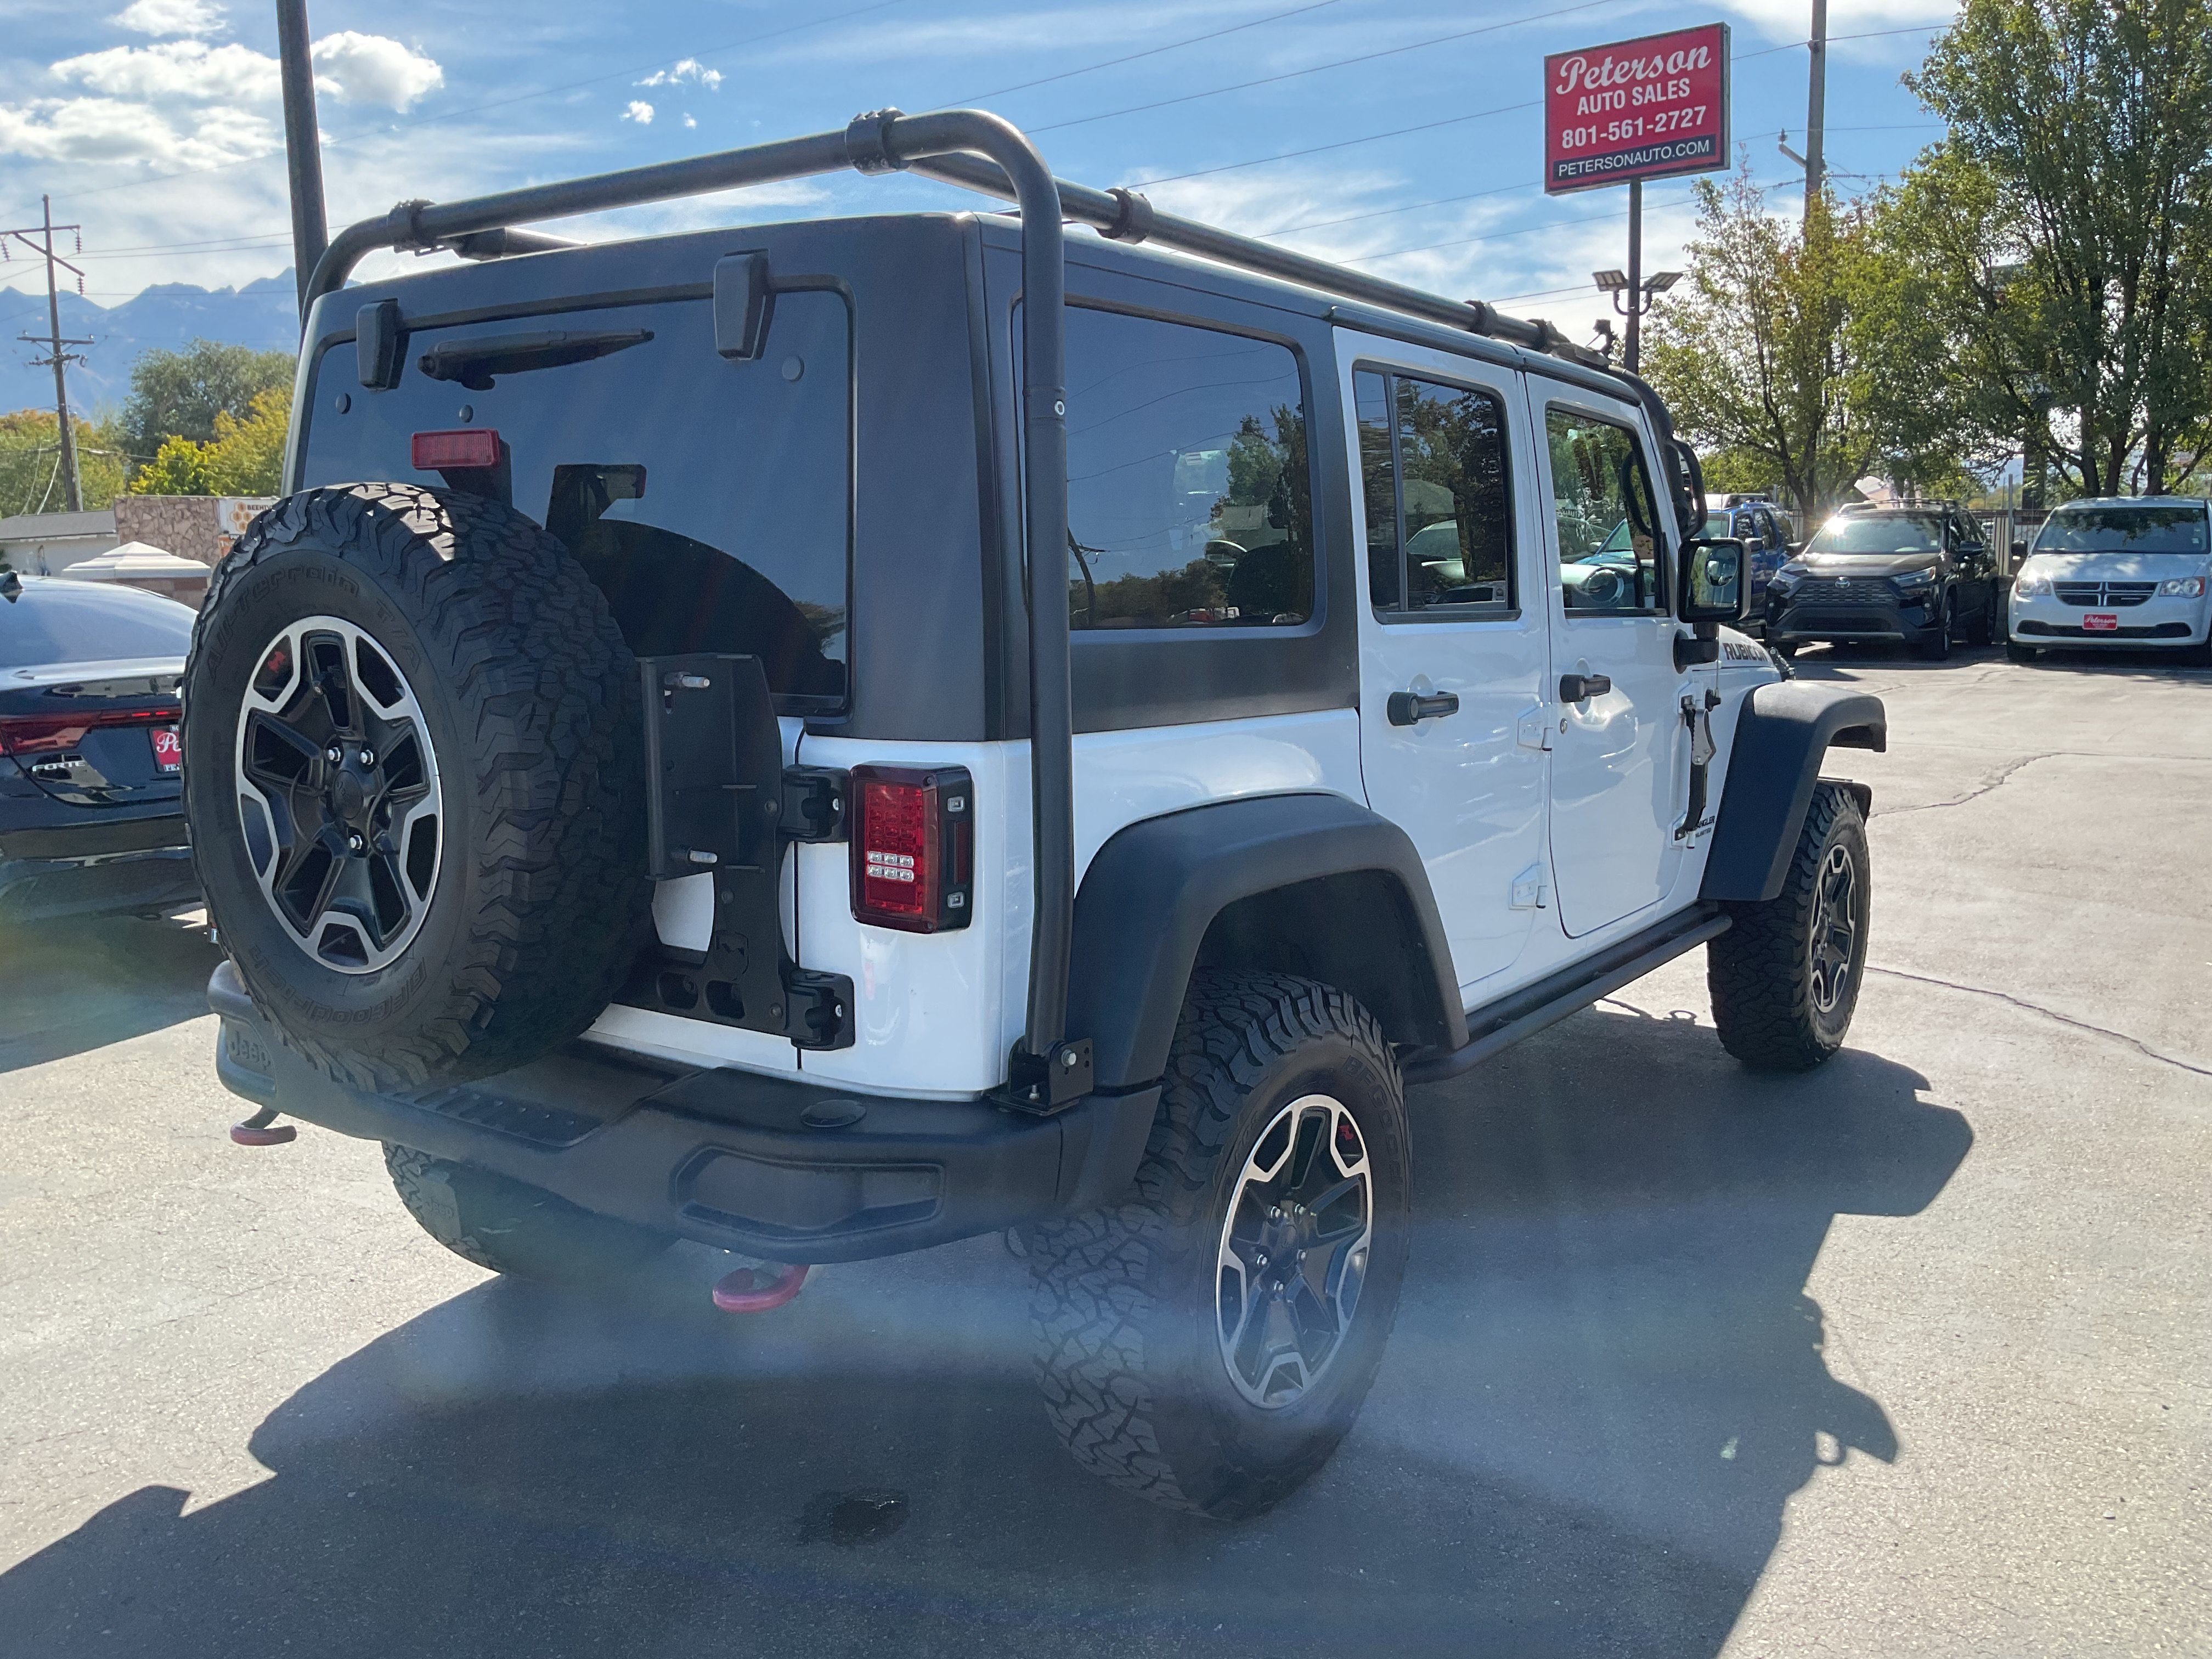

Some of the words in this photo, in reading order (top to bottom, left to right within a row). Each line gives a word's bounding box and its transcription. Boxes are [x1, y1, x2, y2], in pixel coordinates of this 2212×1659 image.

[1556, 46, 1711, 95] Peterson
[1576, 90, 1625, 116] AUTO
[1632, 78, 1690, 106] SALES
[1562, 105, 1707, 149] 801-561-2727
[1559, 139, 1709, 177] PETERSONAUTO.COM
[32, 760, 86, 772] FORTE
[228, 1030, 271, 1072] Jeep
